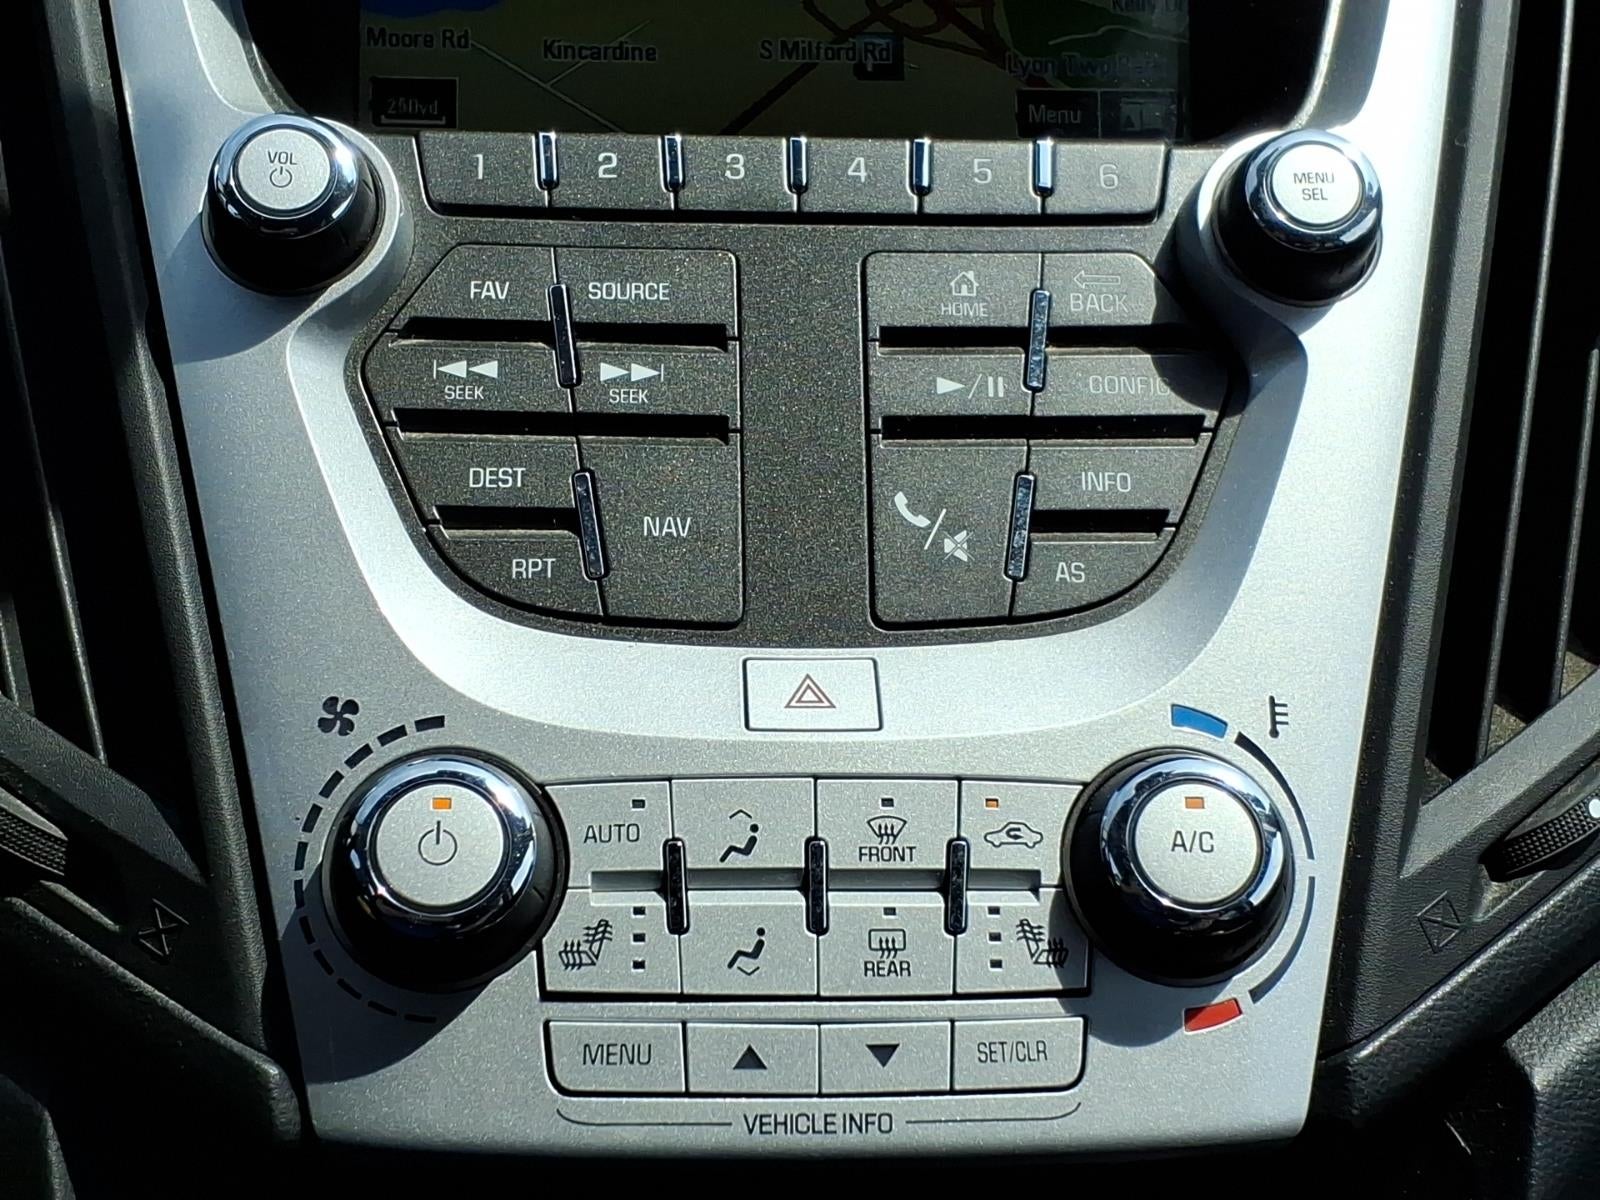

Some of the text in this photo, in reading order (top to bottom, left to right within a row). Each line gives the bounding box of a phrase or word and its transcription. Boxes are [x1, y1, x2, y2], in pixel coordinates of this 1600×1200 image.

[366, 28, 470, 49] Moore Rd
[543, 39, 657, 62] Kincardine
[759, 39, 891, 62] S Milford Rd
[1007, 53, 1056, 78] Lyon
[1028, 104, 1082, 124] Menu
[267, 151, 298, 166] VOL
[473, 154, 484, 180] 1
[598, 153, 618, 179] 2
[725, 153, 745, 180] 3
[847, 157, 868, 183] 4
[973, 158, 993, 184] 5
[1099, 164, 1119, 190] 6
[1293, 171, 1335, 184] MENU
[1301, 188, 1328, 202] SEL
[470, 280, 510, 300] FAV
[588, 282, 670, 301] SOURCE
[940, 302, 989, 317] HOME
[1069, 293, 1129, 313] BACK
[444, 385, 485, 401] SEEK
[608, 388, 649, 404] SEEK
[1089, 375, 1171, 396] CONFIG
[468, 467, 526, 488] DEST
[1080, 471, 1132, 493] INFO
[643, 516, 692, 538] NAV
[511, 558, 556, 579] RPT
[1055, 562, 1086, 583] AS
[583, 823, 641, 844] AUTO
[1170, 830, 1215, 854] A/C
[858, 846, 917, 863] FRONT
[863, 961, 912, 978] REAR
[582, 1043, 652, 1067] MENU
[976, 1040, 1048, 1064] SET/CLR
[744, 1112, 894, 1136] VEHICLE INFO
